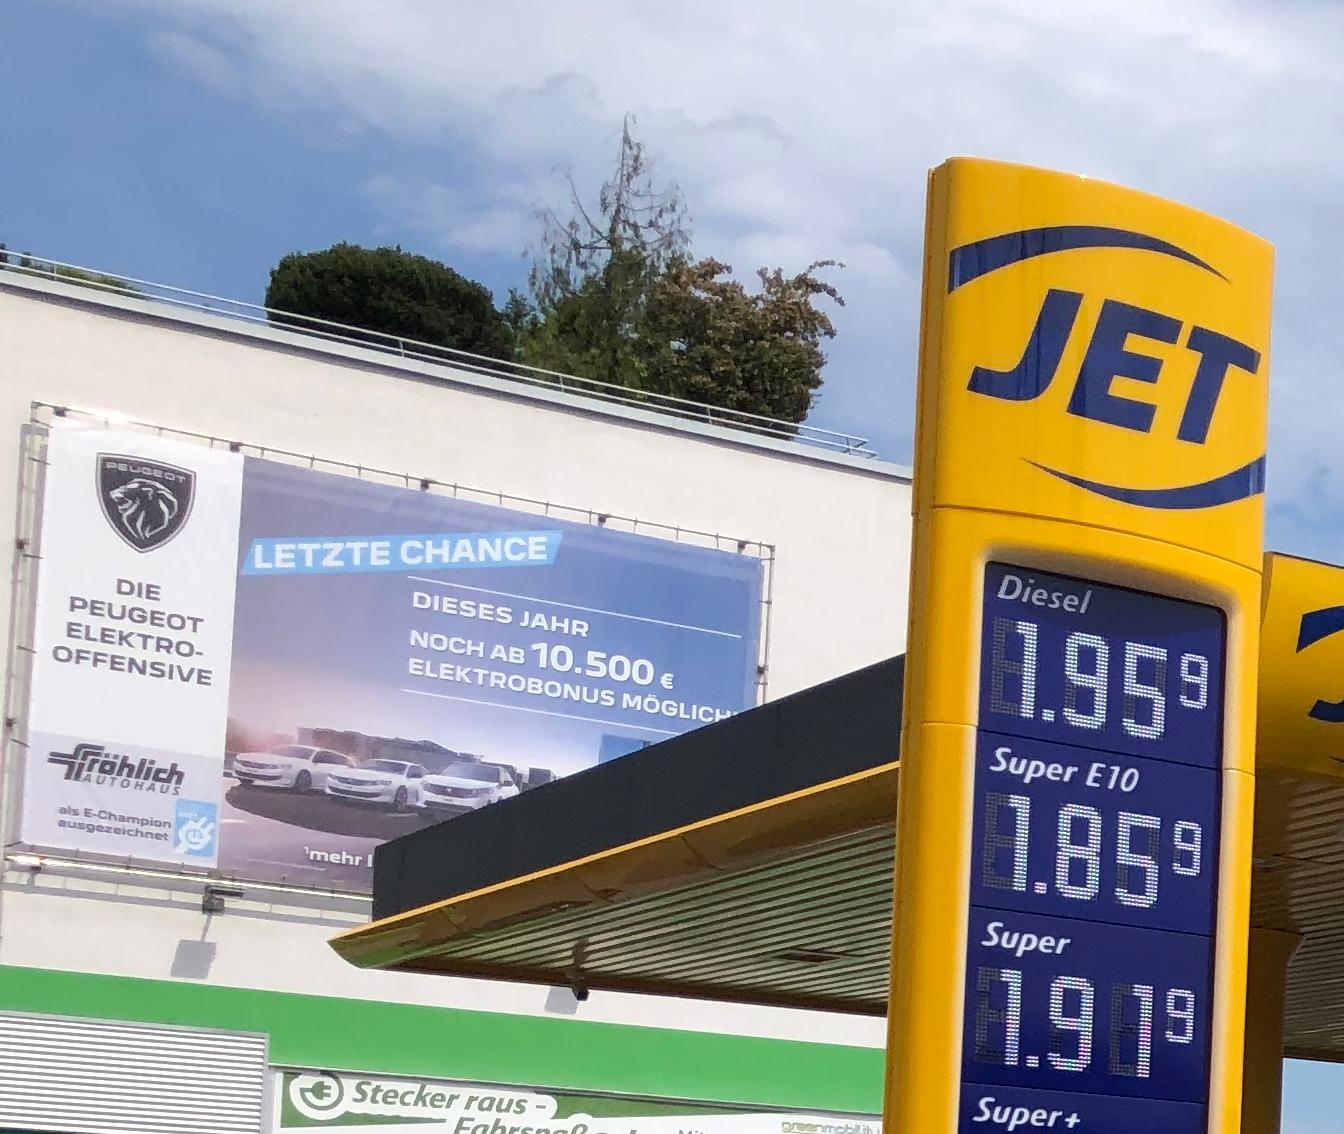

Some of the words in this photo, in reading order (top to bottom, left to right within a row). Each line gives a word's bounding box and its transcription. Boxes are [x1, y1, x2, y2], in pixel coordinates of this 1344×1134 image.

[967, 289, 1262, 445] JET
[105, 461, 187, 483] PEUGEOT
[254, 540, 391, 570] LETZTE
[400, 536, 548, 566] CHANCE
[116, 578, 161, 601] DIE
[997, 574, 1092, 616] Diesel
[69, 595, 204, 633] PEUGEOT
[412, 591, 513, 624] DIESES
[520, 611, 590, 638] JAHR
[65, 621, 204, 658] ELEKTRO-
[52, 645, 213, 686] OFFENSIVE
[409, 629, 486, 659] NOCH
[490, 644, 526, 665] AB
[531, 641, 655, 686] 10.500
[661, 672, 674, 690] €
[407, 657, 615, 708] ELEKTROBONUS
[84, 773, 182, 796] AUTOHAUS
[990, 748, 1078, 785] Super
[1085, 760, 1140, 793] E10
[57, 818, 169, 842] ausgezeichnet
[58, 804, 81, 817] als
[84, 807, 172, 830] E-Champion
[982, 922, 1071, 956] Super
[352, 1080, 460, 1109] Stecker
[464, 1092, 528, 1115] raus
[973, 1097, 1082, 1133] Super+
